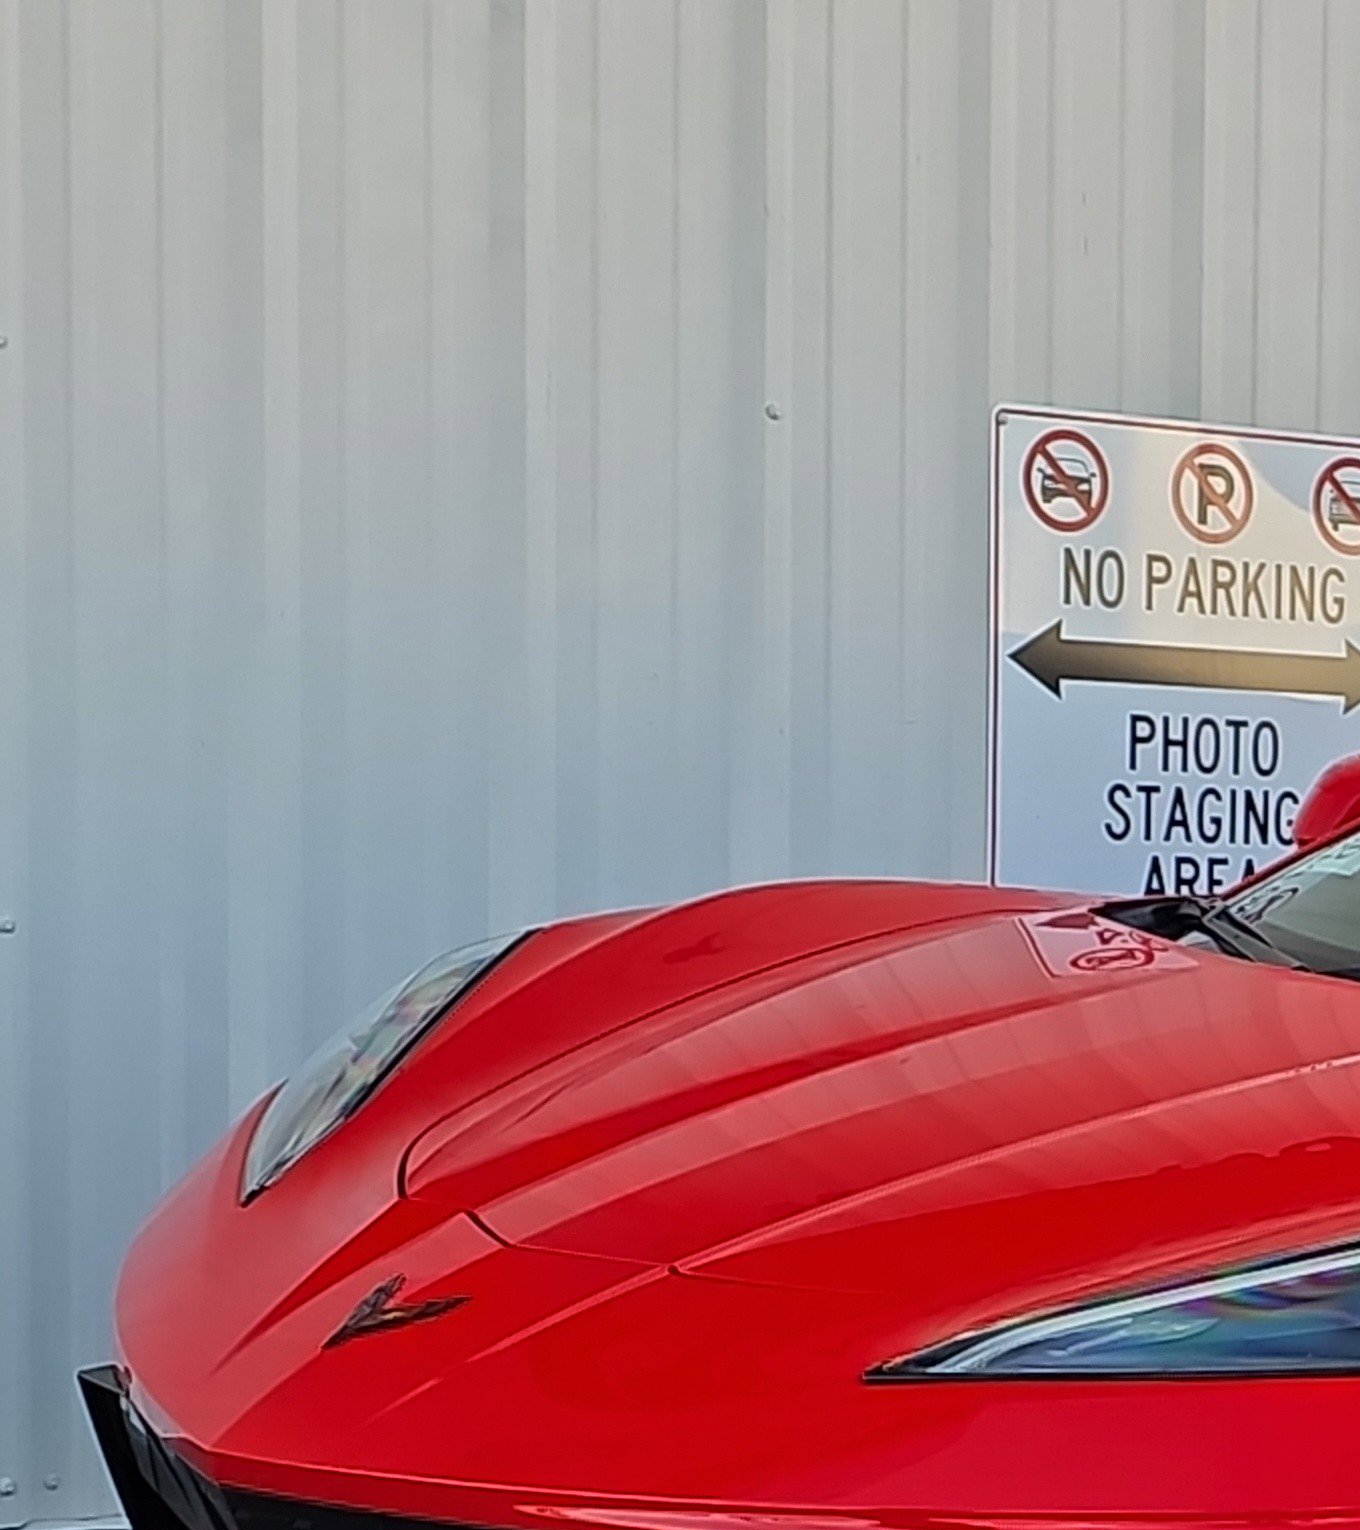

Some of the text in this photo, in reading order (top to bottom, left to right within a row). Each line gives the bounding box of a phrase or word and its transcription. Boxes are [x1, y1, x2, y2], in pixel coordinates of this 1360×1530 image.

[1062, 546, 1346, 624] NO PARKING
[1128, 713, 1280, 778] PHOTO
[1104, 783, 1300, 846] STAGING
